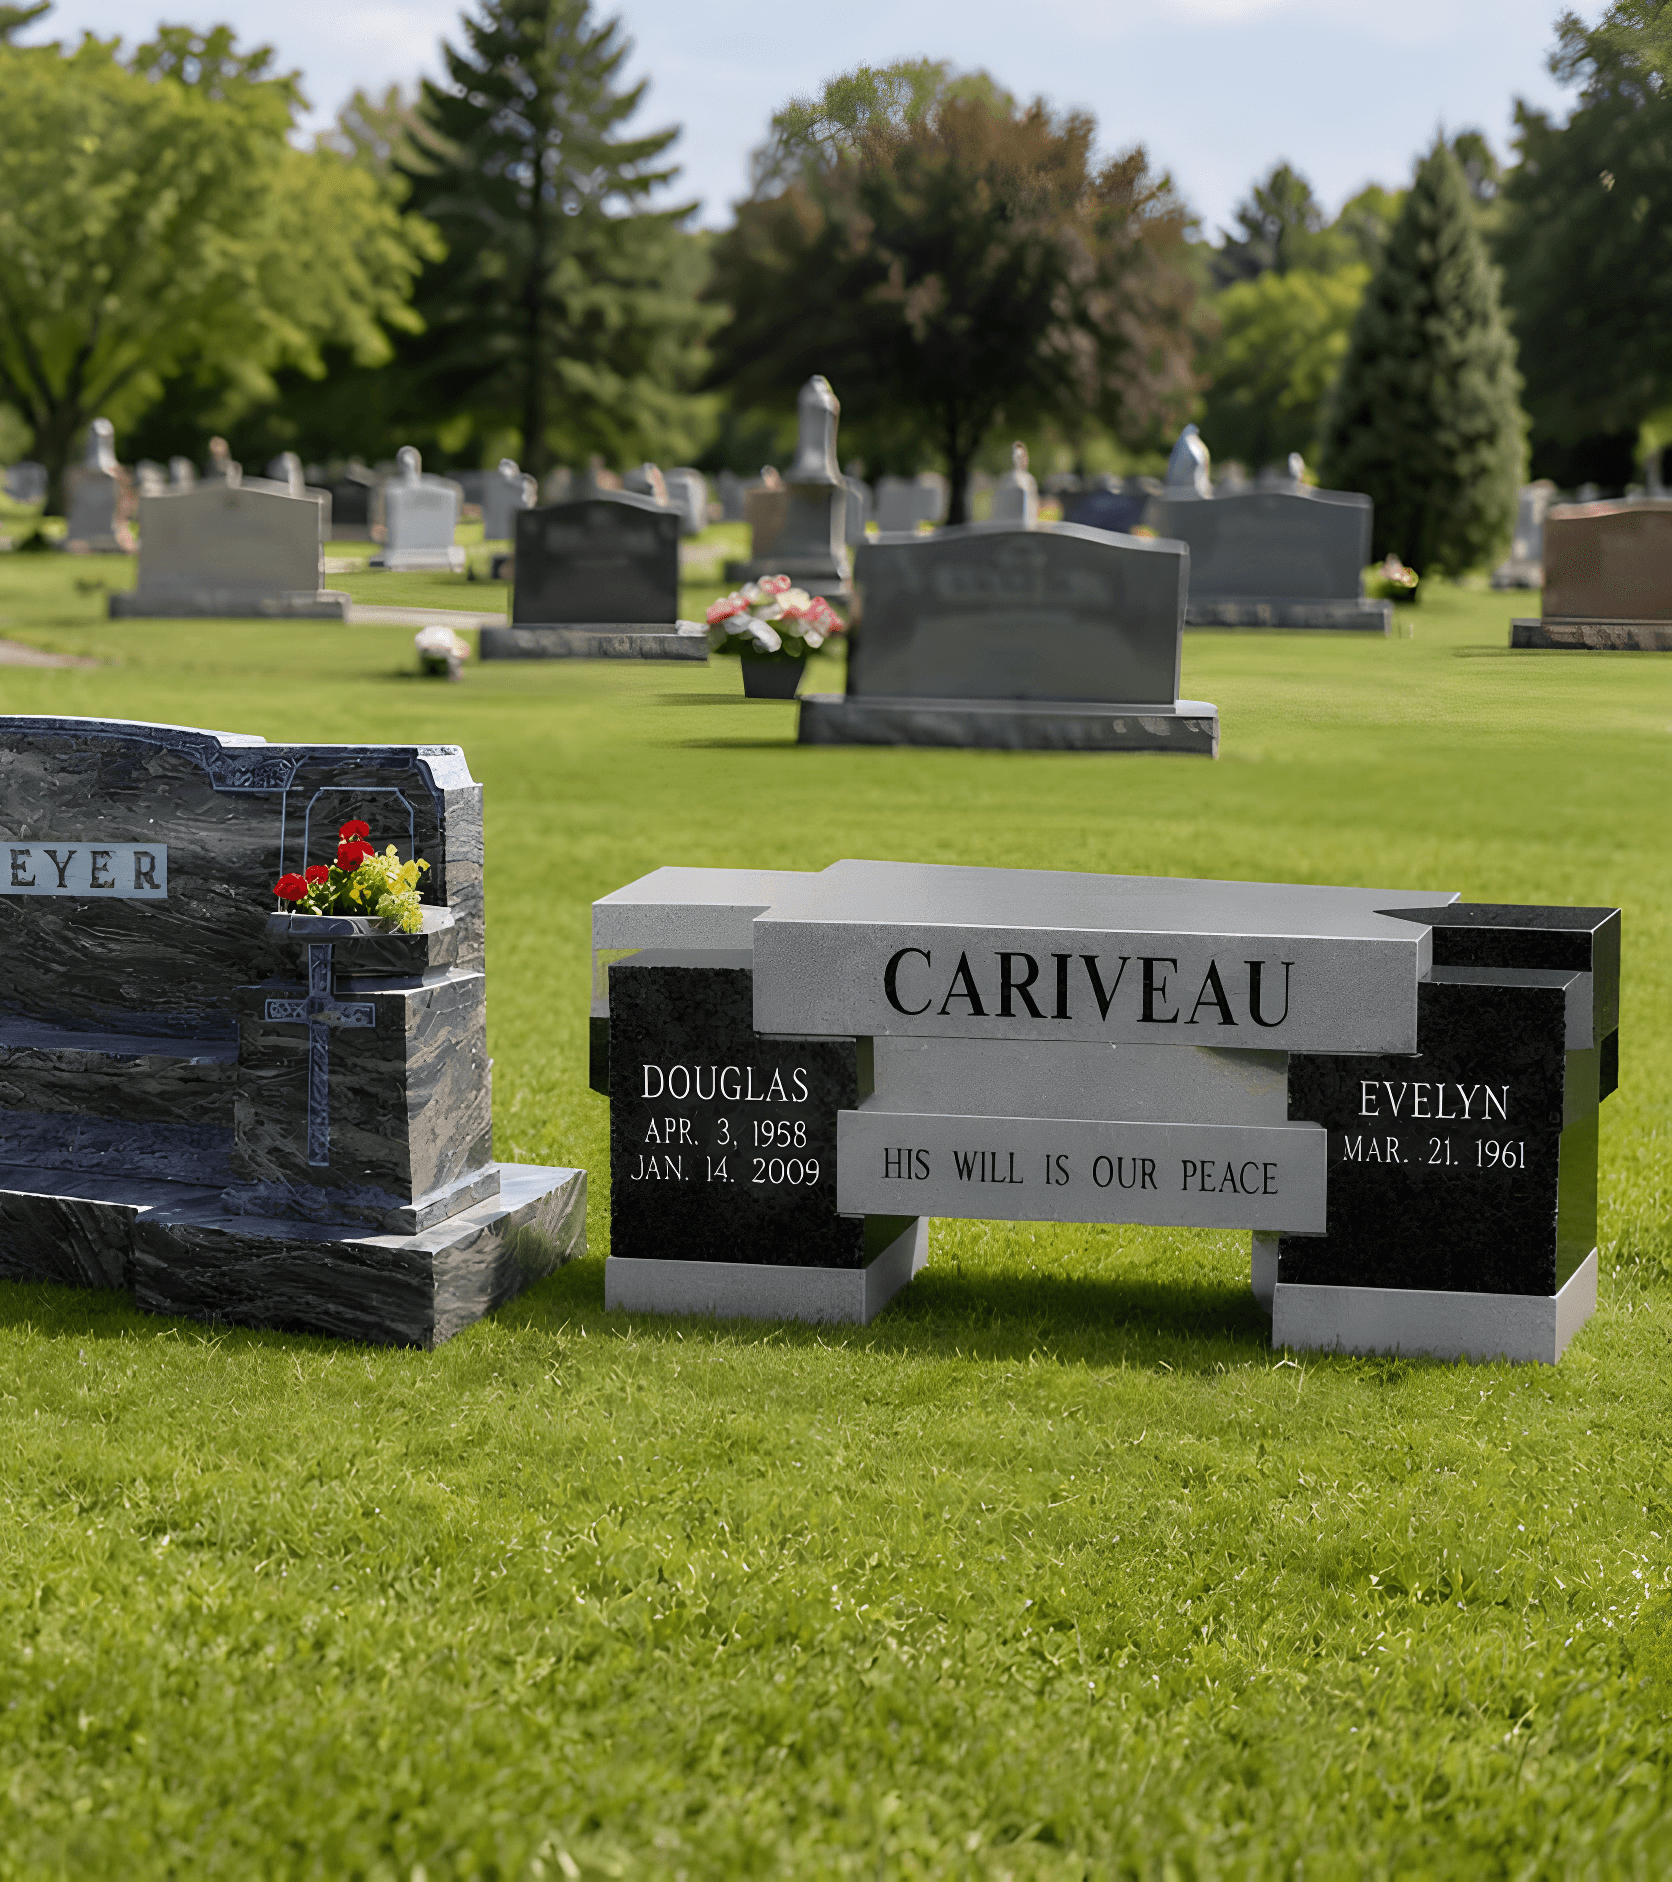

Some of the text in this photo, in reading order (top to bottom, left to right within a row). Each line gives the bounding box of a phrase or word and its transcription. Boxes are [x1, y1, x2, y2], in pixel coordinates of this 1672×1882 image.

[883, 947, 1296, 1028] CARIVEAU
[641, 1064, 809, 1103] DOUGLAS
[1358, 1080, 1510, 1121] EVELYN
[644, 1117, 699, 1146] APR.
[753, 1120, 807, 1148] 1958
[1343, 1135, 1409, 1164] MAR.
[1475, 1139, 1525, 1169] 1961
[631, 1154, 689, 1182] JAN.
[751, 1157, 820, 1186] 2009
[881, 1147, 1279, 1195] HIS WILL IS OUR PEACE
